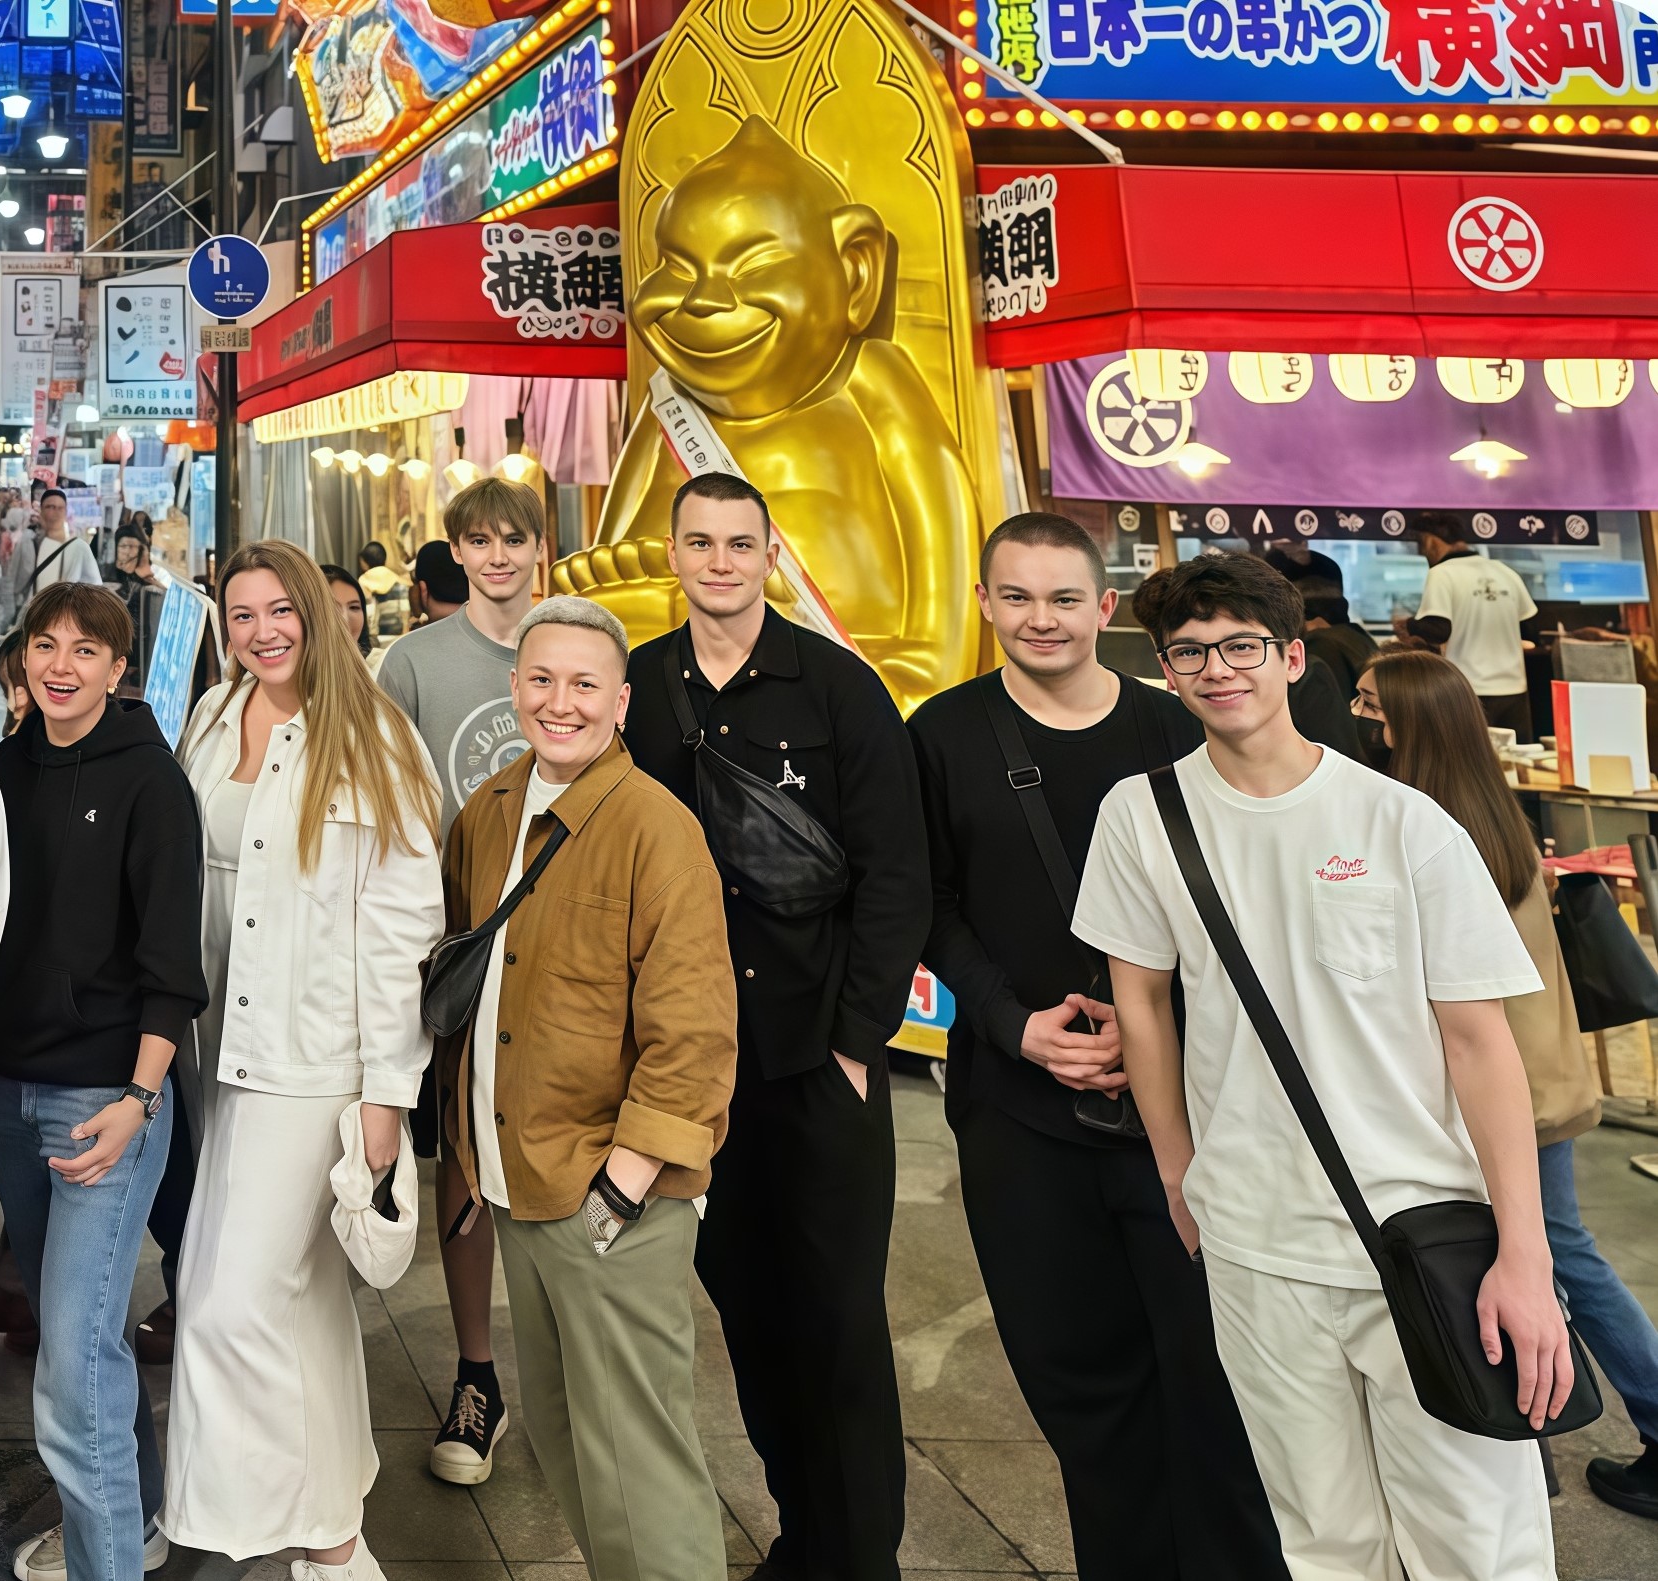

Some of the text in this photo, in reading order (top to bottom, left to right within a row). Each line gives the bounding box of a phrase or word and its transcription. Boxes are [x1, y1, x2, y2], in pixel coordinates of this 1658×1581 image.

[1048, 0, 1371, 60] 日本一の串かつ
